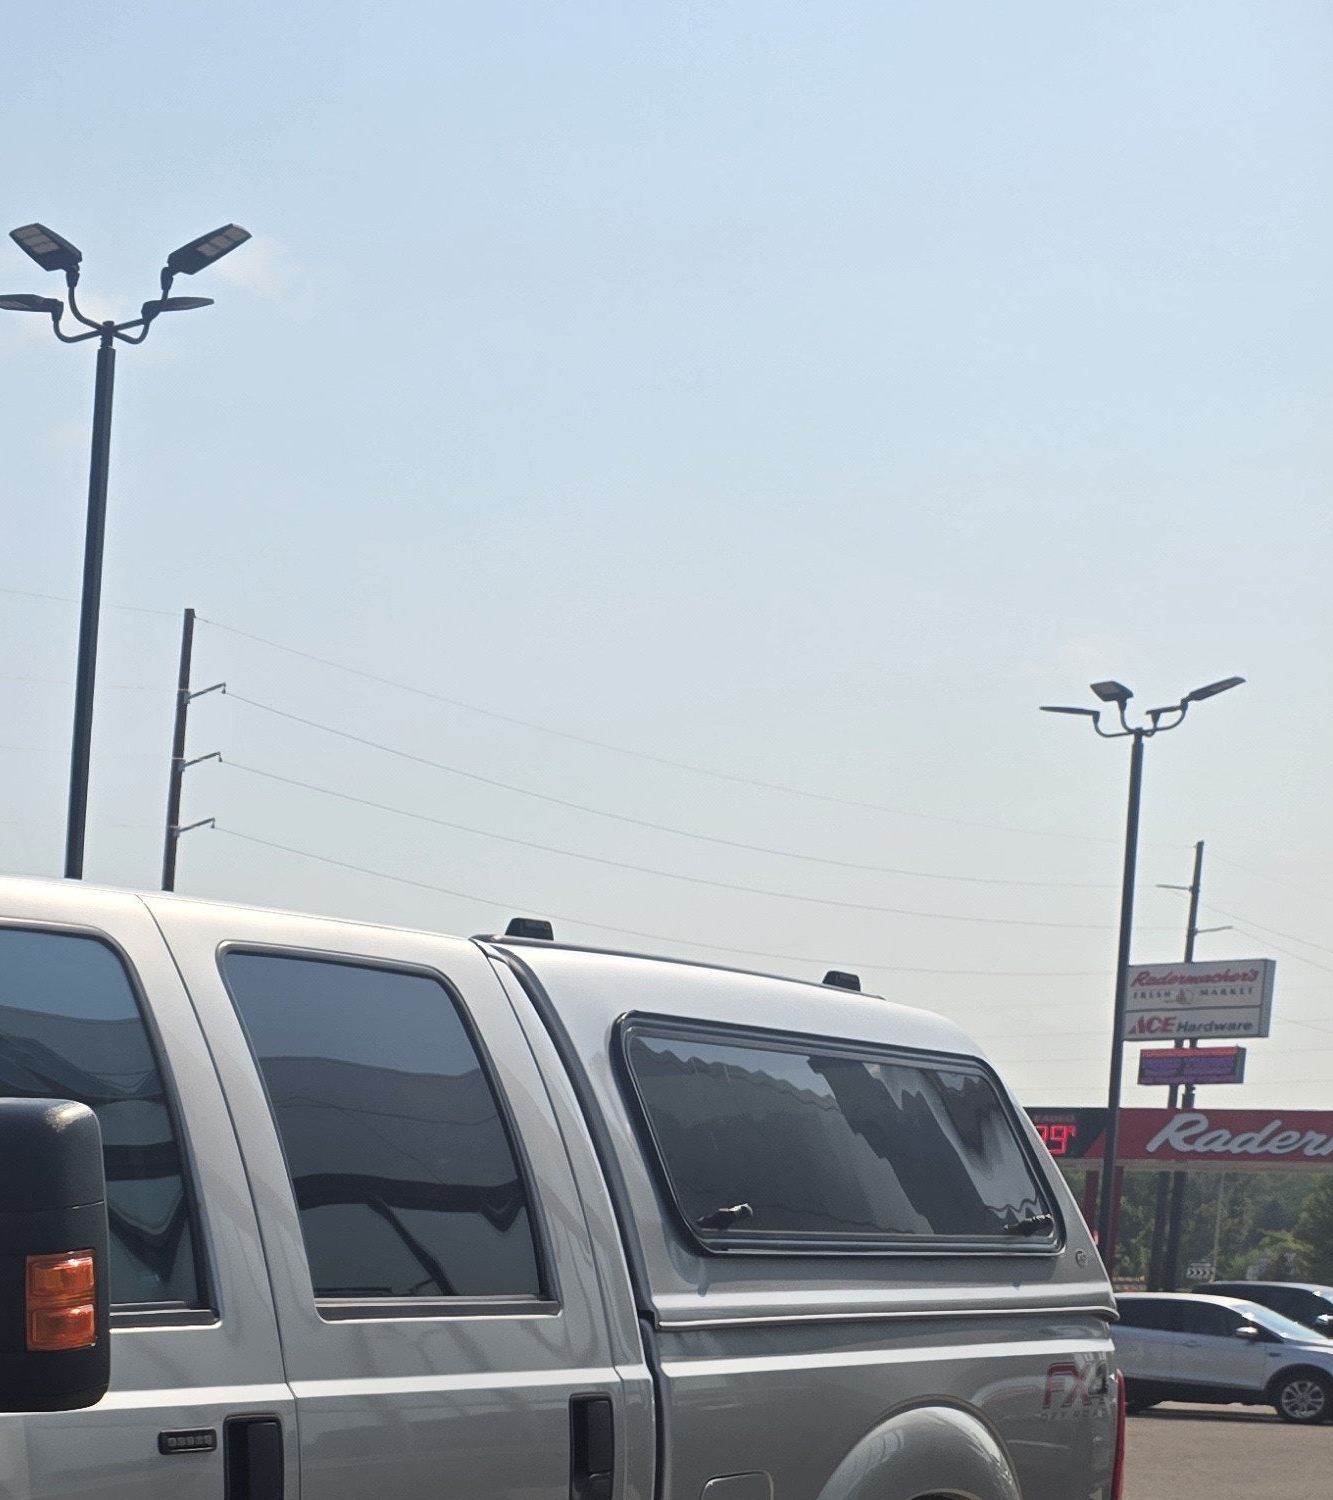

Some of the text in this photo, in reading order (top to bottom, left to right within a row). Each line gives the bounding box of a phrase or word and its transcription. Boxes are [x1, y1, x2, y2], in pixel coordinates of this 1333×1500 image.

[1199, 987, 1253, 996] MARKET
[1128, 1016, 1253, 1034] ACE Hardware
[1146, 1112, 1333, 1157] Rader
